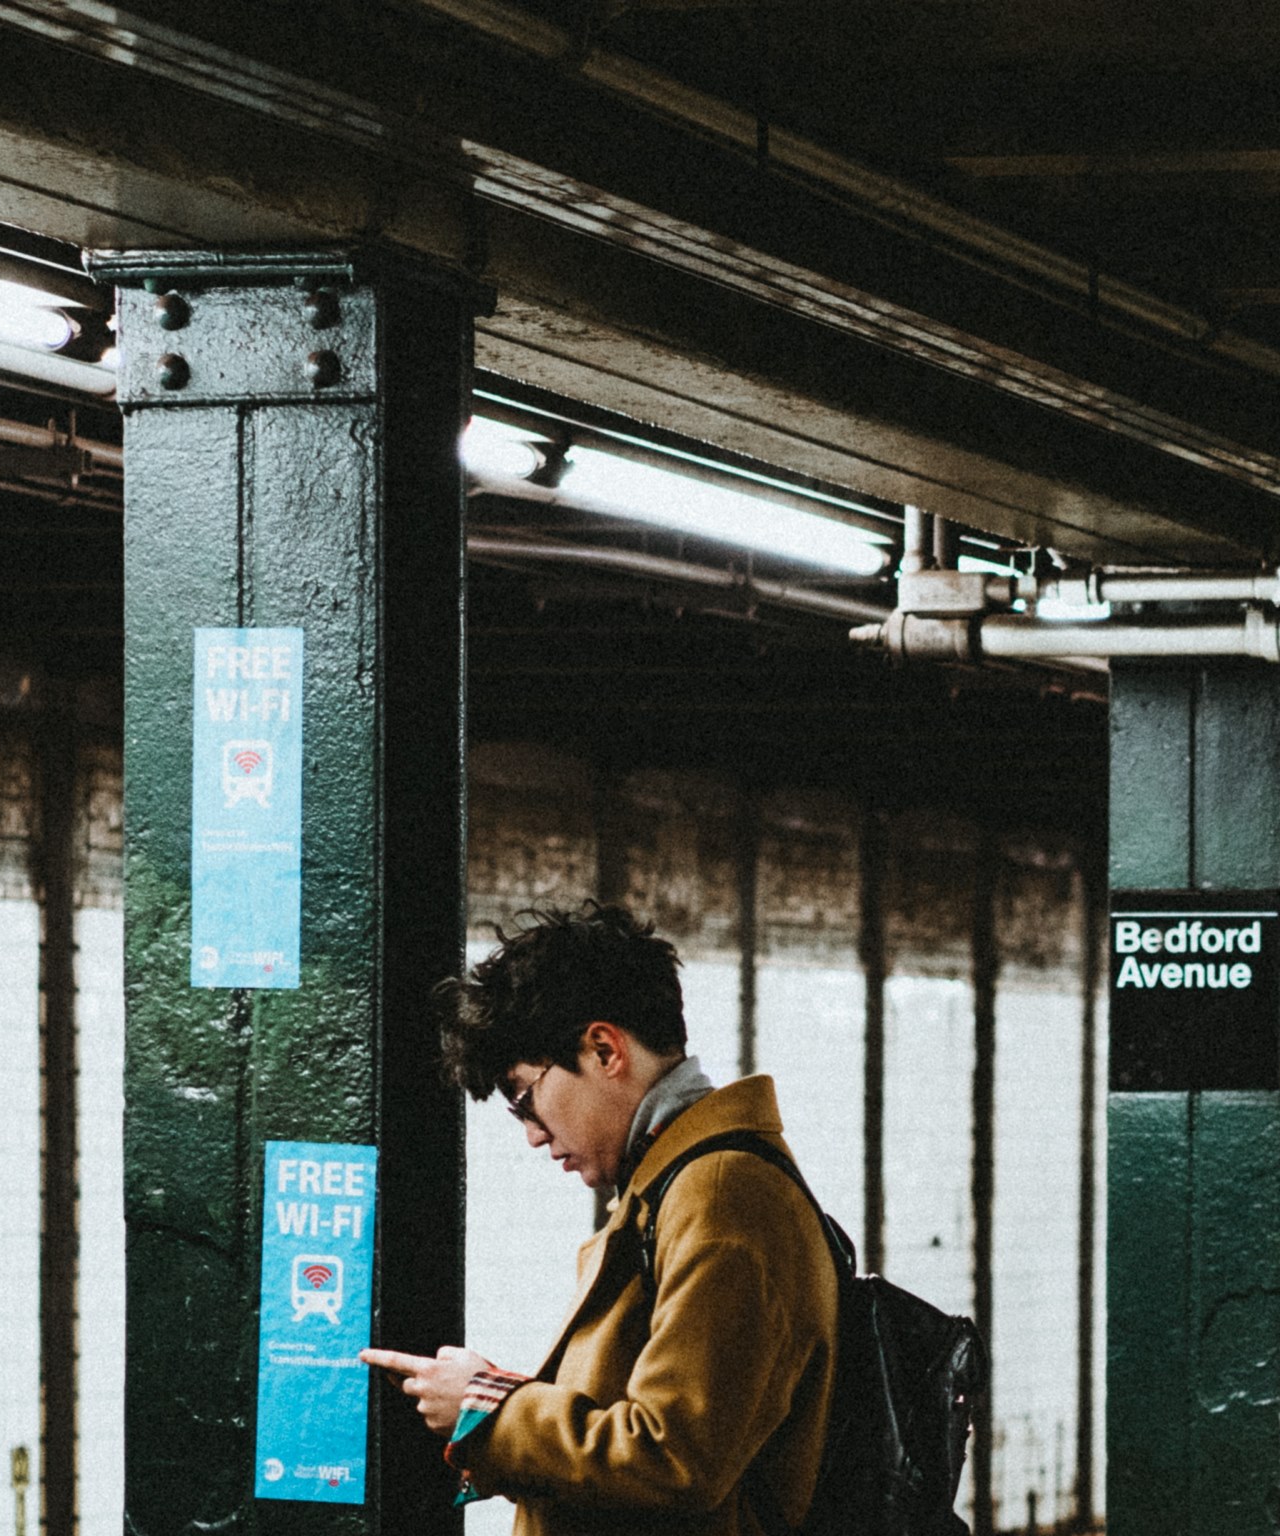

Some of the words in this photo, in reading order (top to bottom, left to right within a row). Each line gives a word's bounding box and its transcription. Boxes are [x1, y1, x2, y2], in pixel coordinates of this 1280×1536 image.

[206, 645, 292, 679] FREE
[205, 687, 291, 721] WI-FI
[1115, 920, 1261, 953] Bedford
[1116, 956, 1252, 989] Avenue
[277, 1159, 365, 1197] FREE
[276, 1202, 362, 1239] WI-FI
